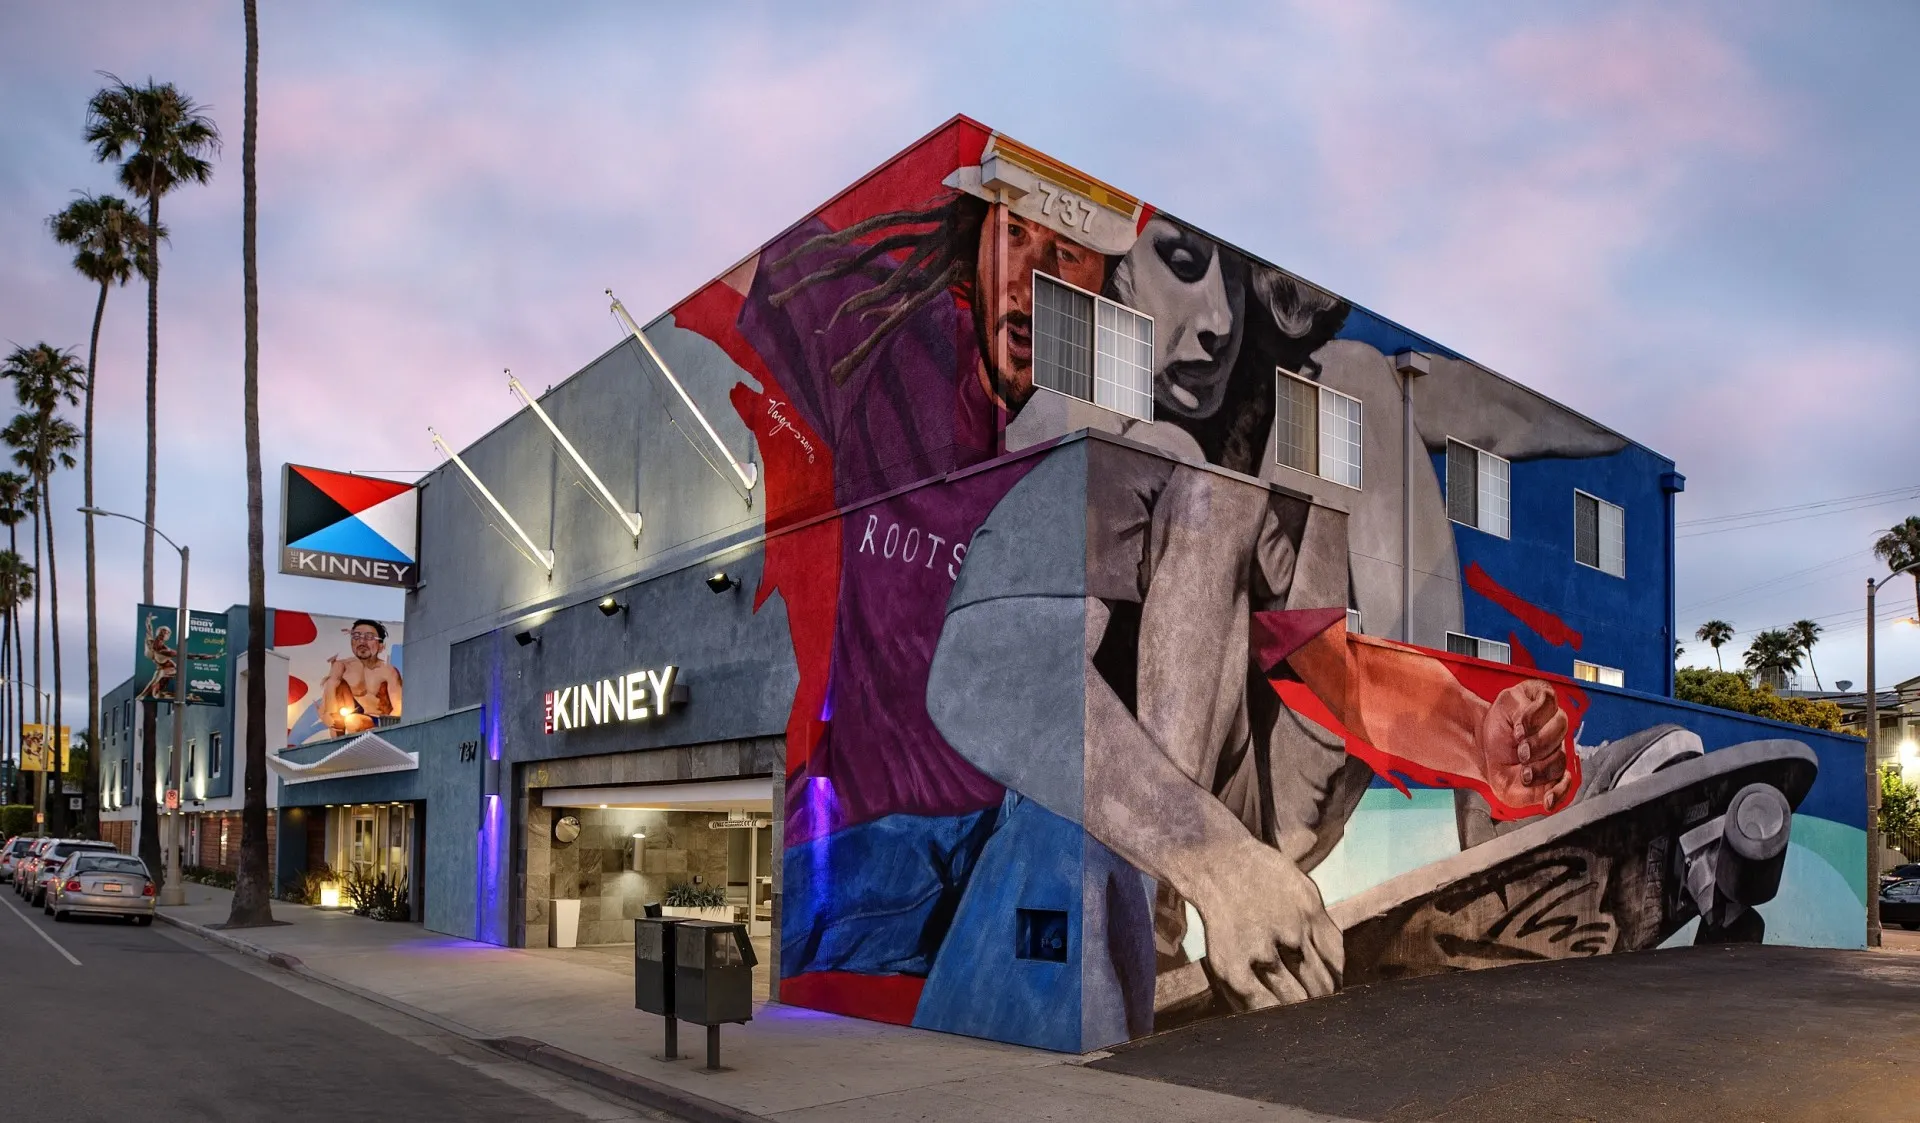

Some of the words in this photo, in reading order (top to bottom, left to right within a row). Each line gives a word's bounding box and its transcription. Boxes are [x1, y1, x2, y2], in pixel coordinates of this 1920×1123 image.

[1038, 182, 1097, 233] 737
[300, 552, 409, 581] KINNEY
[859, 515, 966, 580] ROOTS
[191, 626, 226, 634] WORLDS
[544, 692, 553, 733] THE
[553, 666, 676, 731] KINNEY
